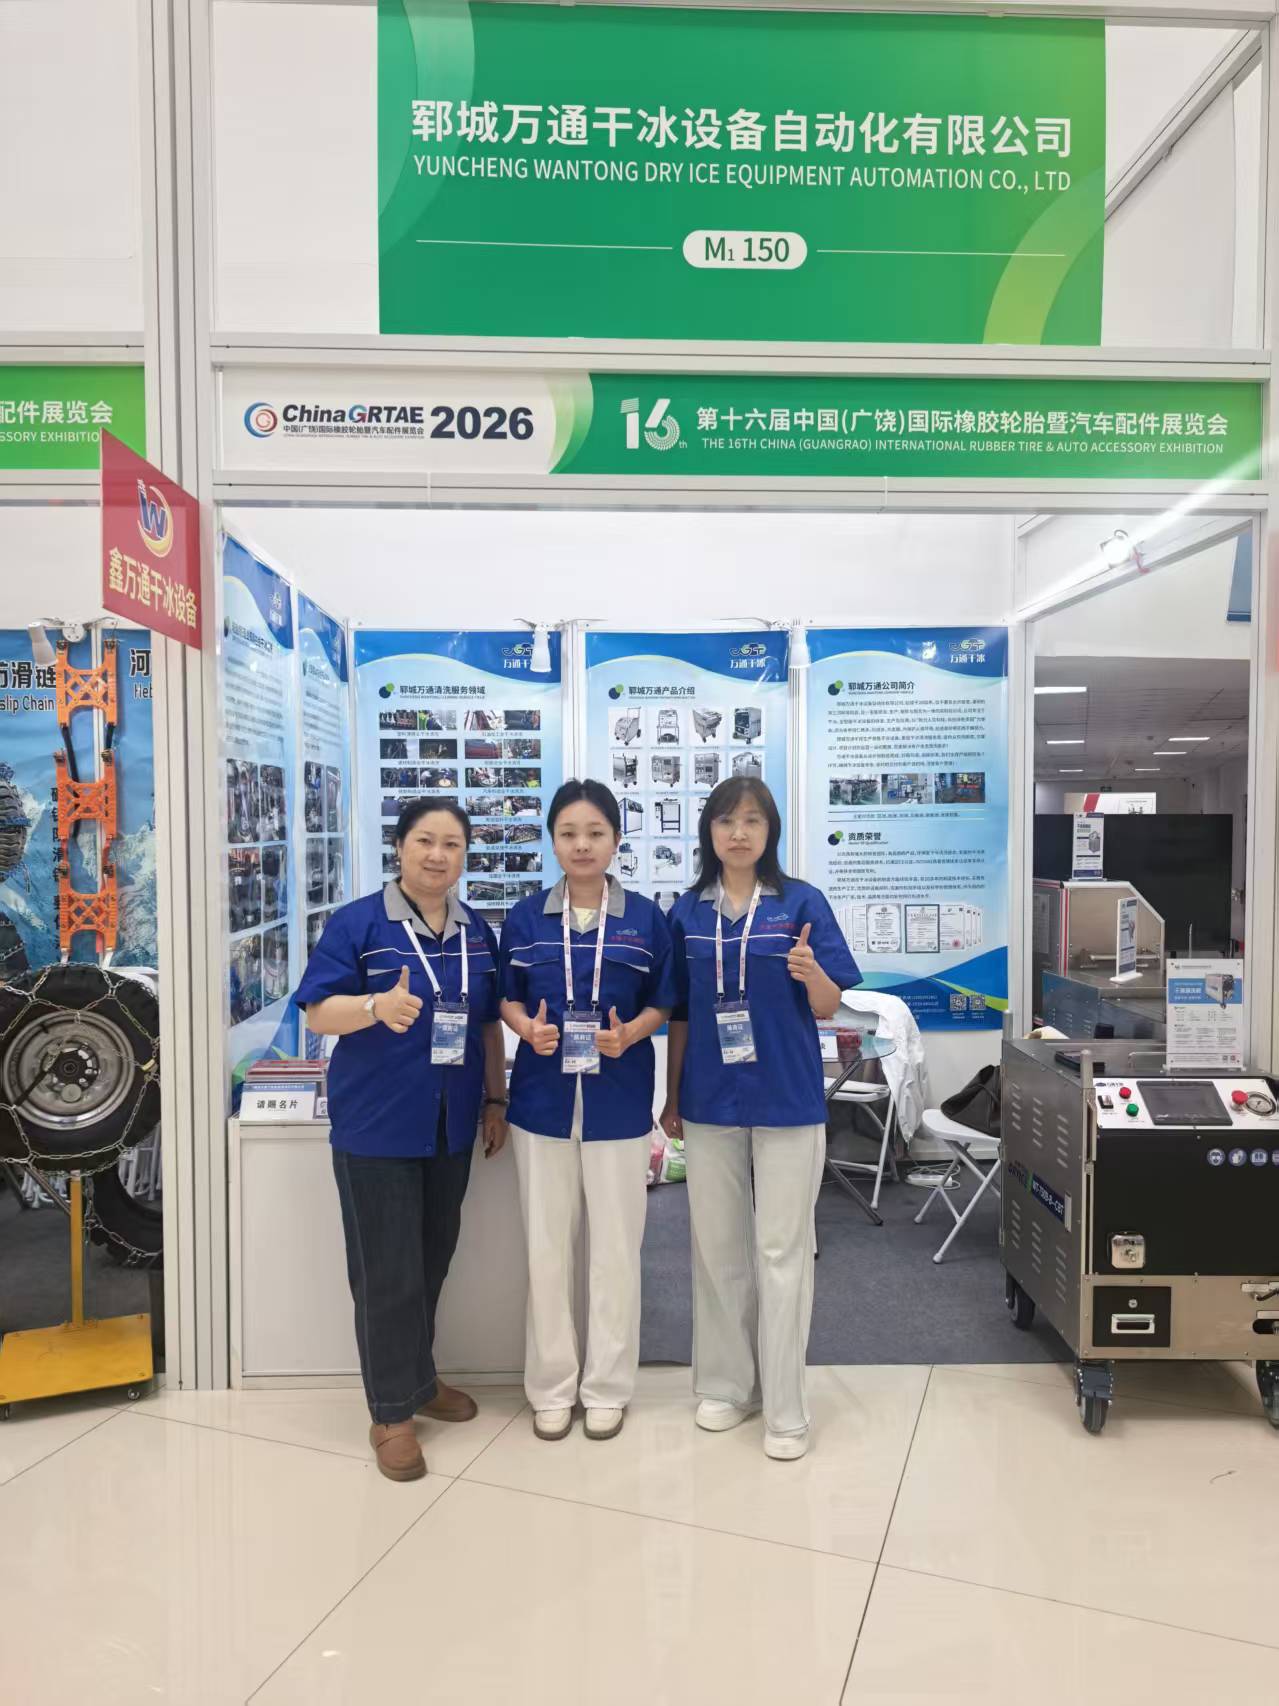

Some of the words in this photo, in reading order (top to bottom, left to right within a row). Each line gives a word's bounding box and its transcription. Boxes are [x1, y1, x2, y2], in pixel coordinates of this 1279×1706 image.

[411, 100, 1072, 159] 郓城万通干冰设备自动化有限公司
[414, 155, 528, 178] YUNCHENG
[533, 159, 639, 182] WANTONG
[645, 162, 683, 183] DRY
[689, 163, 720, 184] ICE
[726, 163, 847, 189] EQUIPMENT
[850, 167, 983, 190] AUTOMATION
[989, 169, 1028, 194] CO.,
[1034, 171, 1071, 191] LTD
[742, 237, 790, 263] 150
[430, 405, 534, 440] 2026
[696, 407, 1229, 436] 第十六届中国(广饶)国际橡胶轮胎暨汽车配件展览会
[40, 431, 101, 443] EXHIBITIO
[702, 437, 725, 449] THE
[728, 438, 756, 450] 16TH
[760, 438, 797, 450] CHINA
[799, 438, 872, 452] (GUANGRAO)
[875, 439, 967, 451] INTERNATIONAL
[969, 440, 1015, 452] RUBBER
[1018, 441, 1043, 452] TIRE
[1046, 441, 1055, 452] &
[1056, 442, 1088, 452] AUTO
[1091, 442, 1156, 453] ACCESSORY
[1159, 442, 1224, 454] EXHIBITION
[109, 546, 197, 629] 鑫万通干冰设备
[628, 686, 696, 696] 郓城万通产品介绍
[848, 681, 915, 691] 郓城万通公司简介
[22, 695, 55, 711] Chain
[848, 831, 882, 841] 资质荣誉
